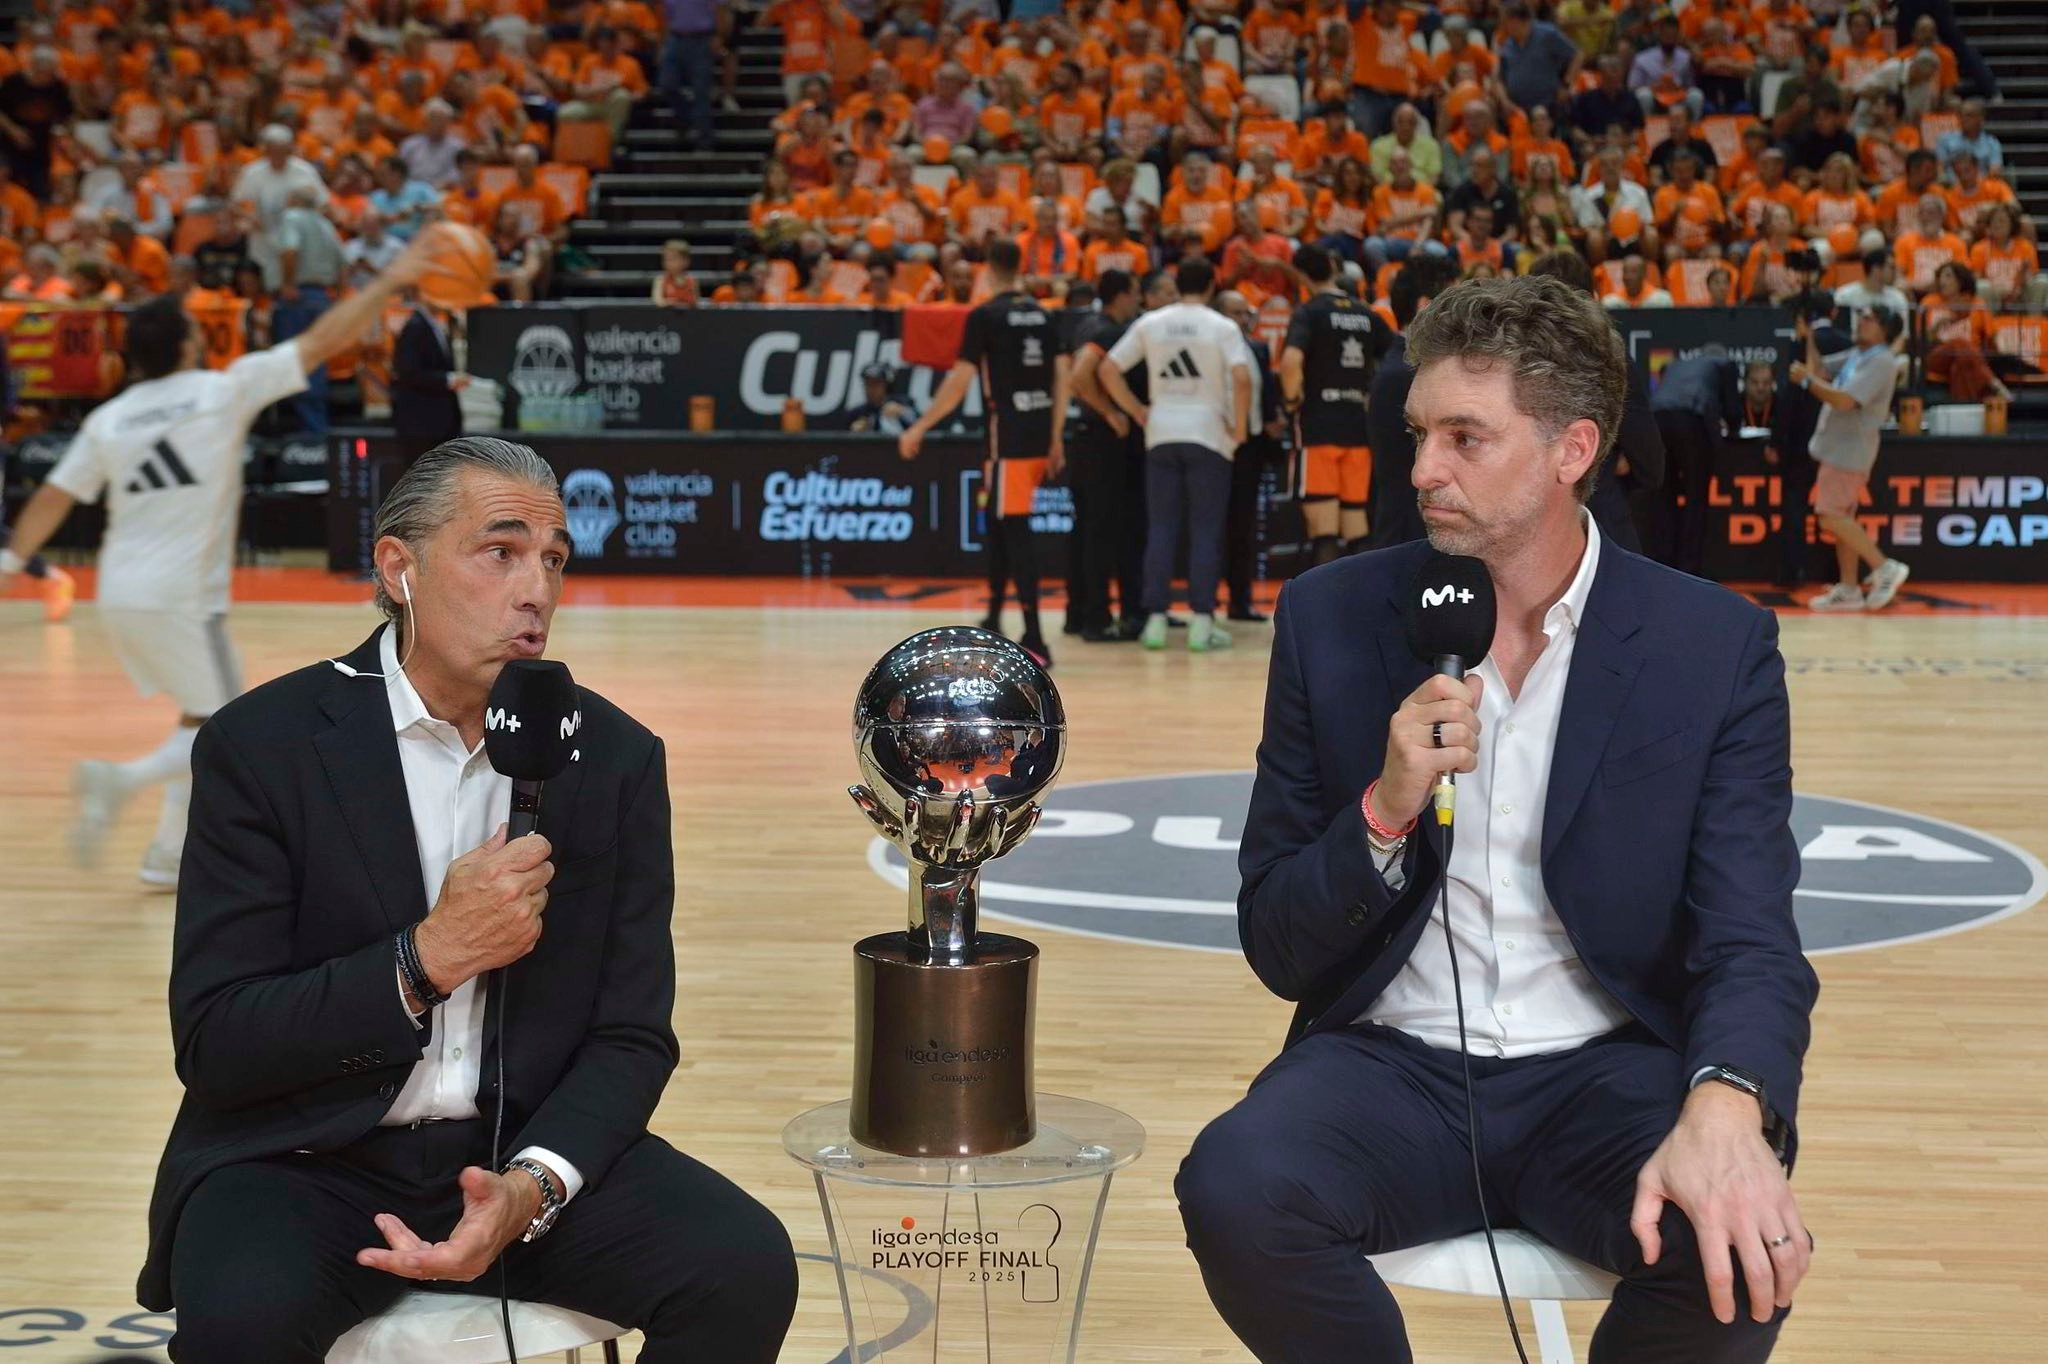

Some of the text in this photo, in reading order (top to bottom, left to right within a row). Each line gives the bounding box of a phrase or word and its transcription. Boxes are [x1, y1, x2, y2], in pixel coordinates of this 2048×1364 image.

[584, 324, 681, 355] valencia
[623, 470, 714, 498] valencia
[763, 471, 883, 506] Cultura
[1889, 476, 2048, 507] TEMP
[623, 496, 699, 524] basket
[759, 504, 914, 542] Esfuerzo
[623, 522, 677, 548] club
[872, 1251, 1043, 1269] PLAYOFF FINAL
[969, 1271, 1015, 1282] 2025
